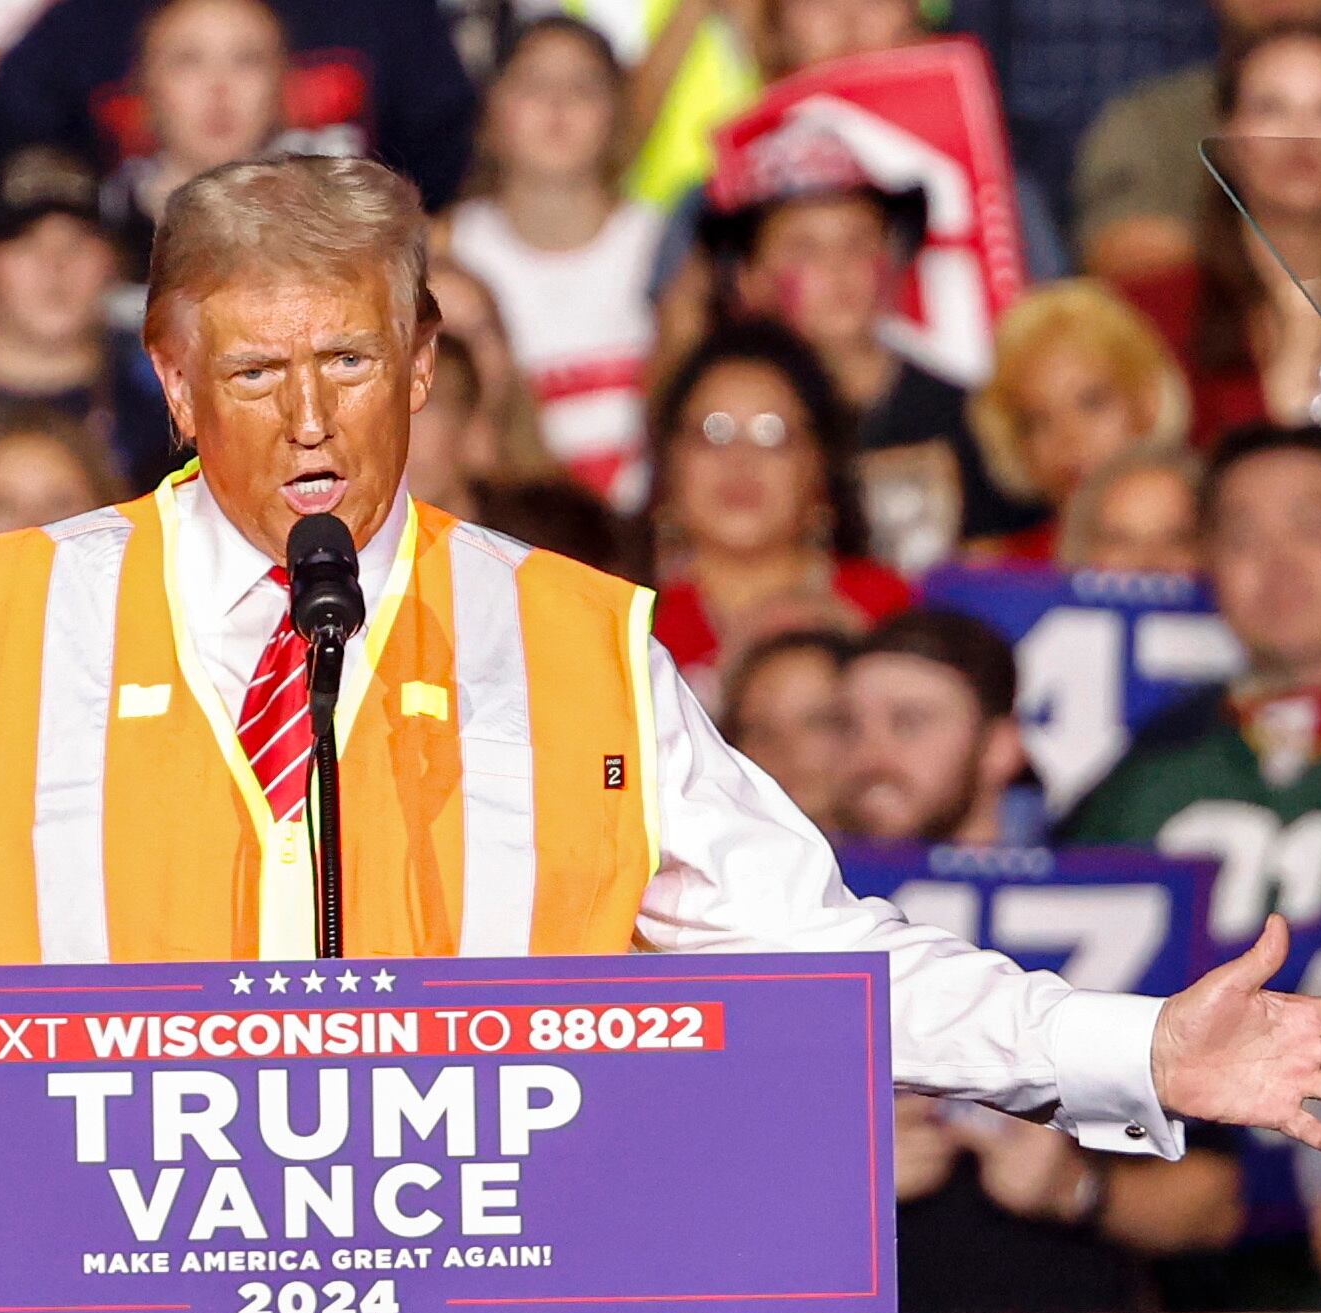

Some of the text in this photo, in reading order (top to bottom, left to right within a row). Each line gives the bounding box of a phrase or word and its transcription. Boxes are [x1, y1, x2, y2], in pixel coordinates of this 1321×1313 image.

[608, 767, 621, 785] 2
[84, 1012, 418, 1058] WISCONSIN
[435, 1010, 511, 1052] TO
[529, 1006, 704, 1051] 88022
[47, 1064, 582, 1164] TRUMP
[108, 1162, 522, 1242] VANCE
[83, 1245, 552, 1274] MAKE AMERICA GREAT AGAIN!
